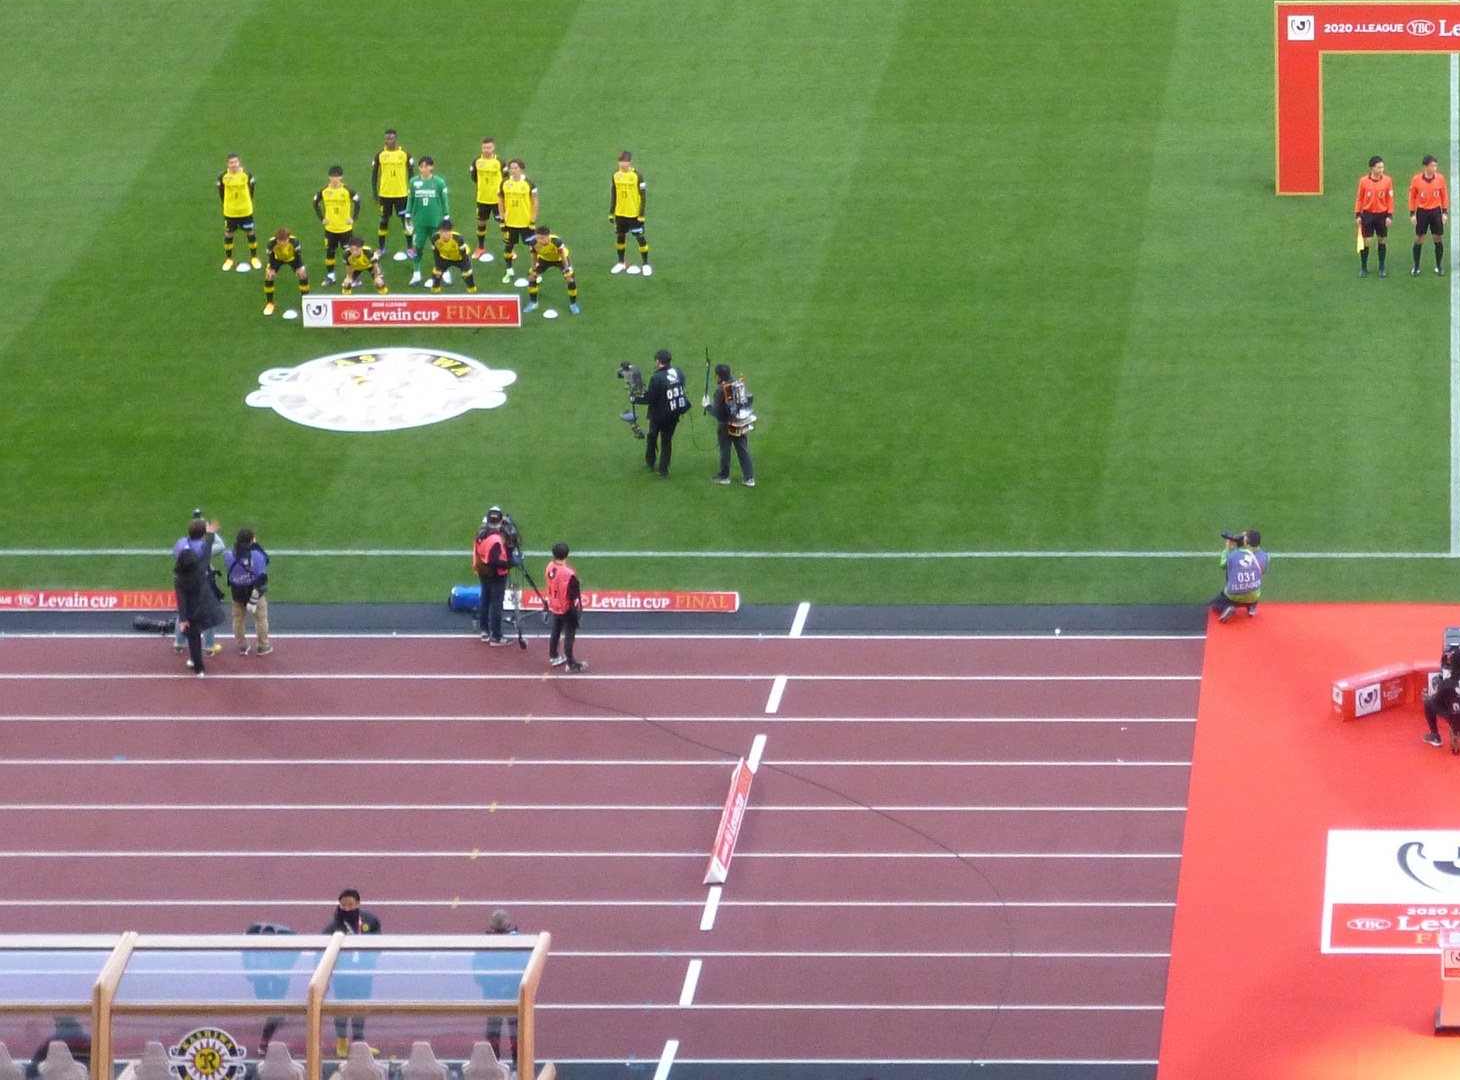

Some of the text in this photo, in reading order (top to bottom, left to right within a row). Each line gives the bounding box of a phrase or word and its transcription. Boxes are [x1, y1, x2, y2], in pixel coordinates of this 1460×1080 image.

[1324, 23, 1353, 33] 2020
[1354, 23, 1404, 33] J.LEAGUE
[1410, 22, 1432, 35] YBC
[363, 308, 411, 322] Levain
[414, 311, 440, 321] CUP
[446, 305, 510, 320] FINAL
[1238, 572, 1256, 583] 031
[38, 592, 88, 608] Levain
[90, 597, 118, 608] CUP
[122, 594, 176, 608] FINAL
[591, 594, 729, 609] Levain CUP FINAL
[1407, 907, 1448, 916] 2020
[1354, 920, 1384, 930] YBC
